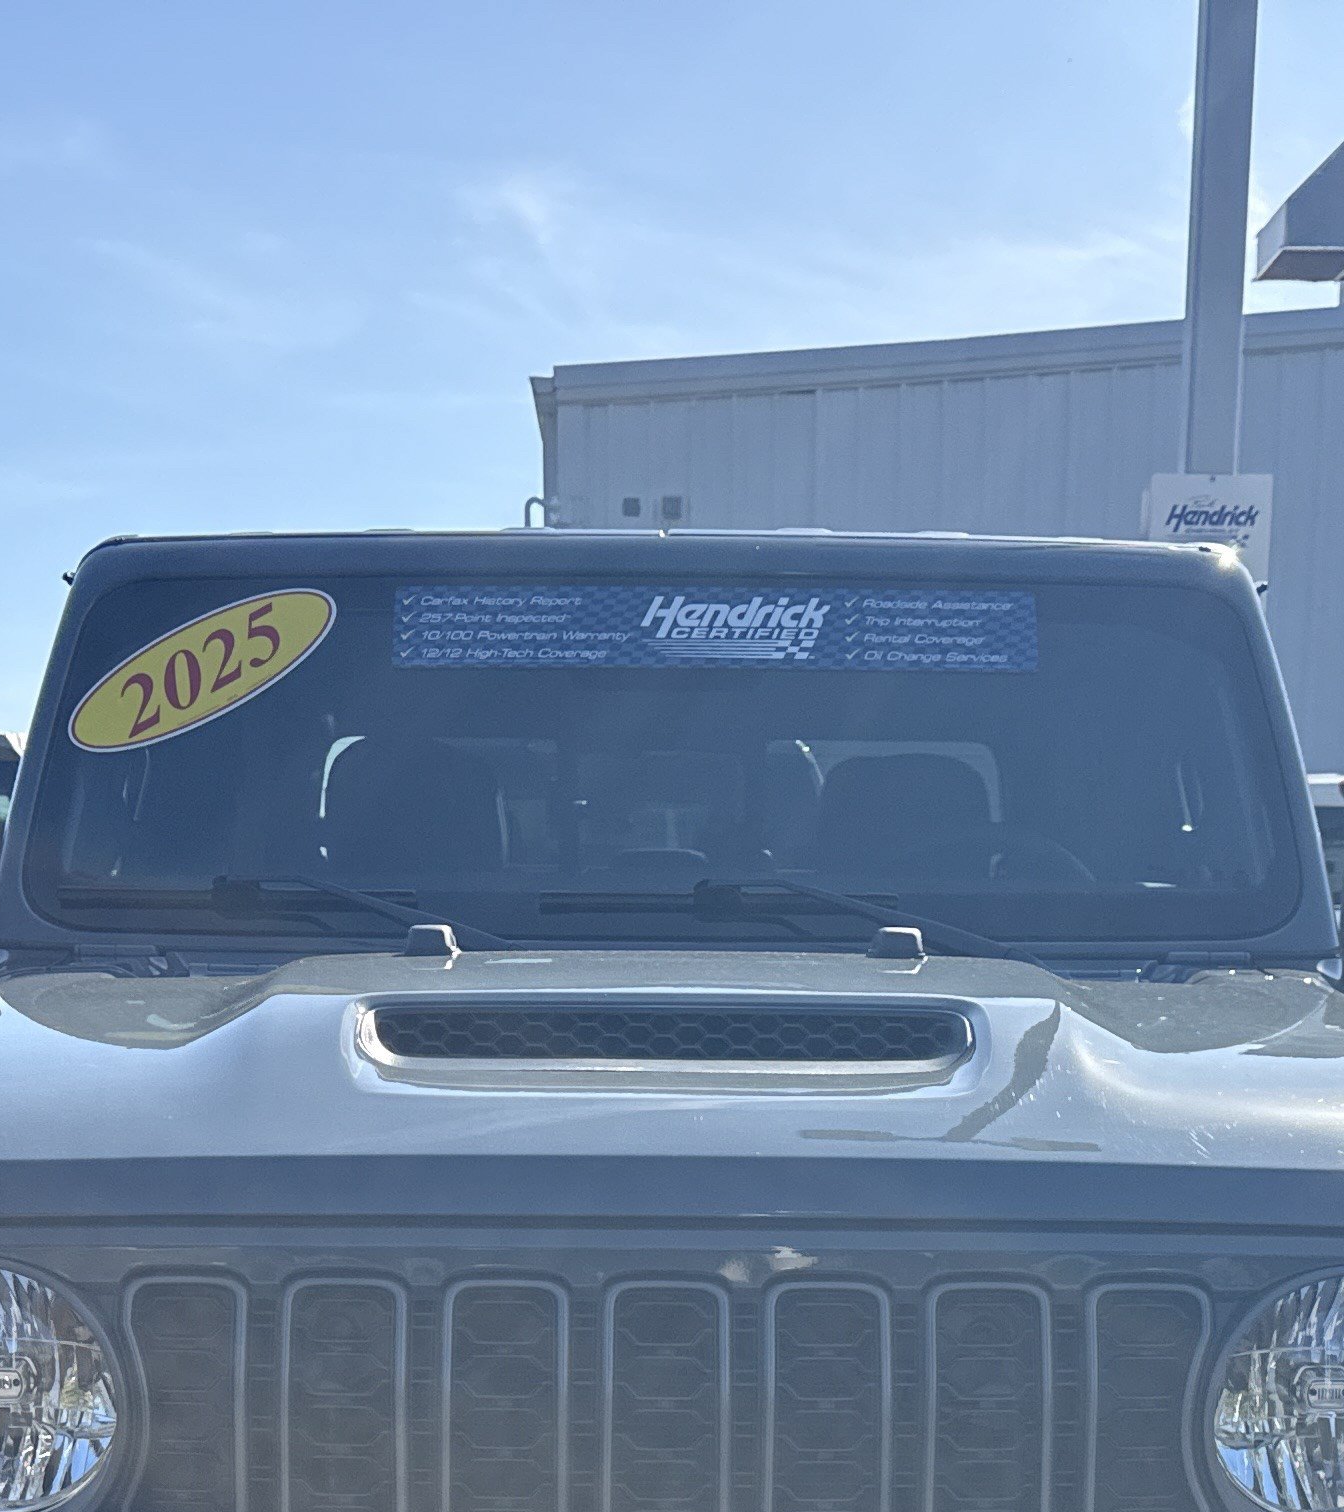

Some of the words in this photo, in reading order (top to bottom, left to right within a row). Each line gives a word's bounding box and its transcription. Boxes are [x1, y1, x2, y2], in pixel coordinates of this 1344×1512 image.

[1165, 504, 1259, 532] Hendrick
[420, 595, 468, 606] Carfax
[473, 595, 526, 607] History
[529, 595, 582, 607] Report
[862, 599, 928, 610] Roadside
[932, 600, 1014, 611] Assistance
[640, 595, 831, 639] Hendrick
[865, 616, 890, 627] Trip
[894, 616, 982, 627] Interruption
[421, 630, 474, 641] 10/100
[477, 630, 557, 641] Powertrain
[563, 630, 631, 643] Warranty
[670, 627, 820, 640] CERTIFIED
[864, 633, 911, 644] Rental
[914, 634, 985, 646] Coverage
[421, 648, 463, 659] 12/12
[466, 648, 534, 660] High-Tech
[538, 648, 608, 660] Coverage
[864, 651, 882, 661] Oil
[887, 651, 941, 663] Change
[945, 652, 1008, 663] Services
[120, 602, 281, 739] 2025
